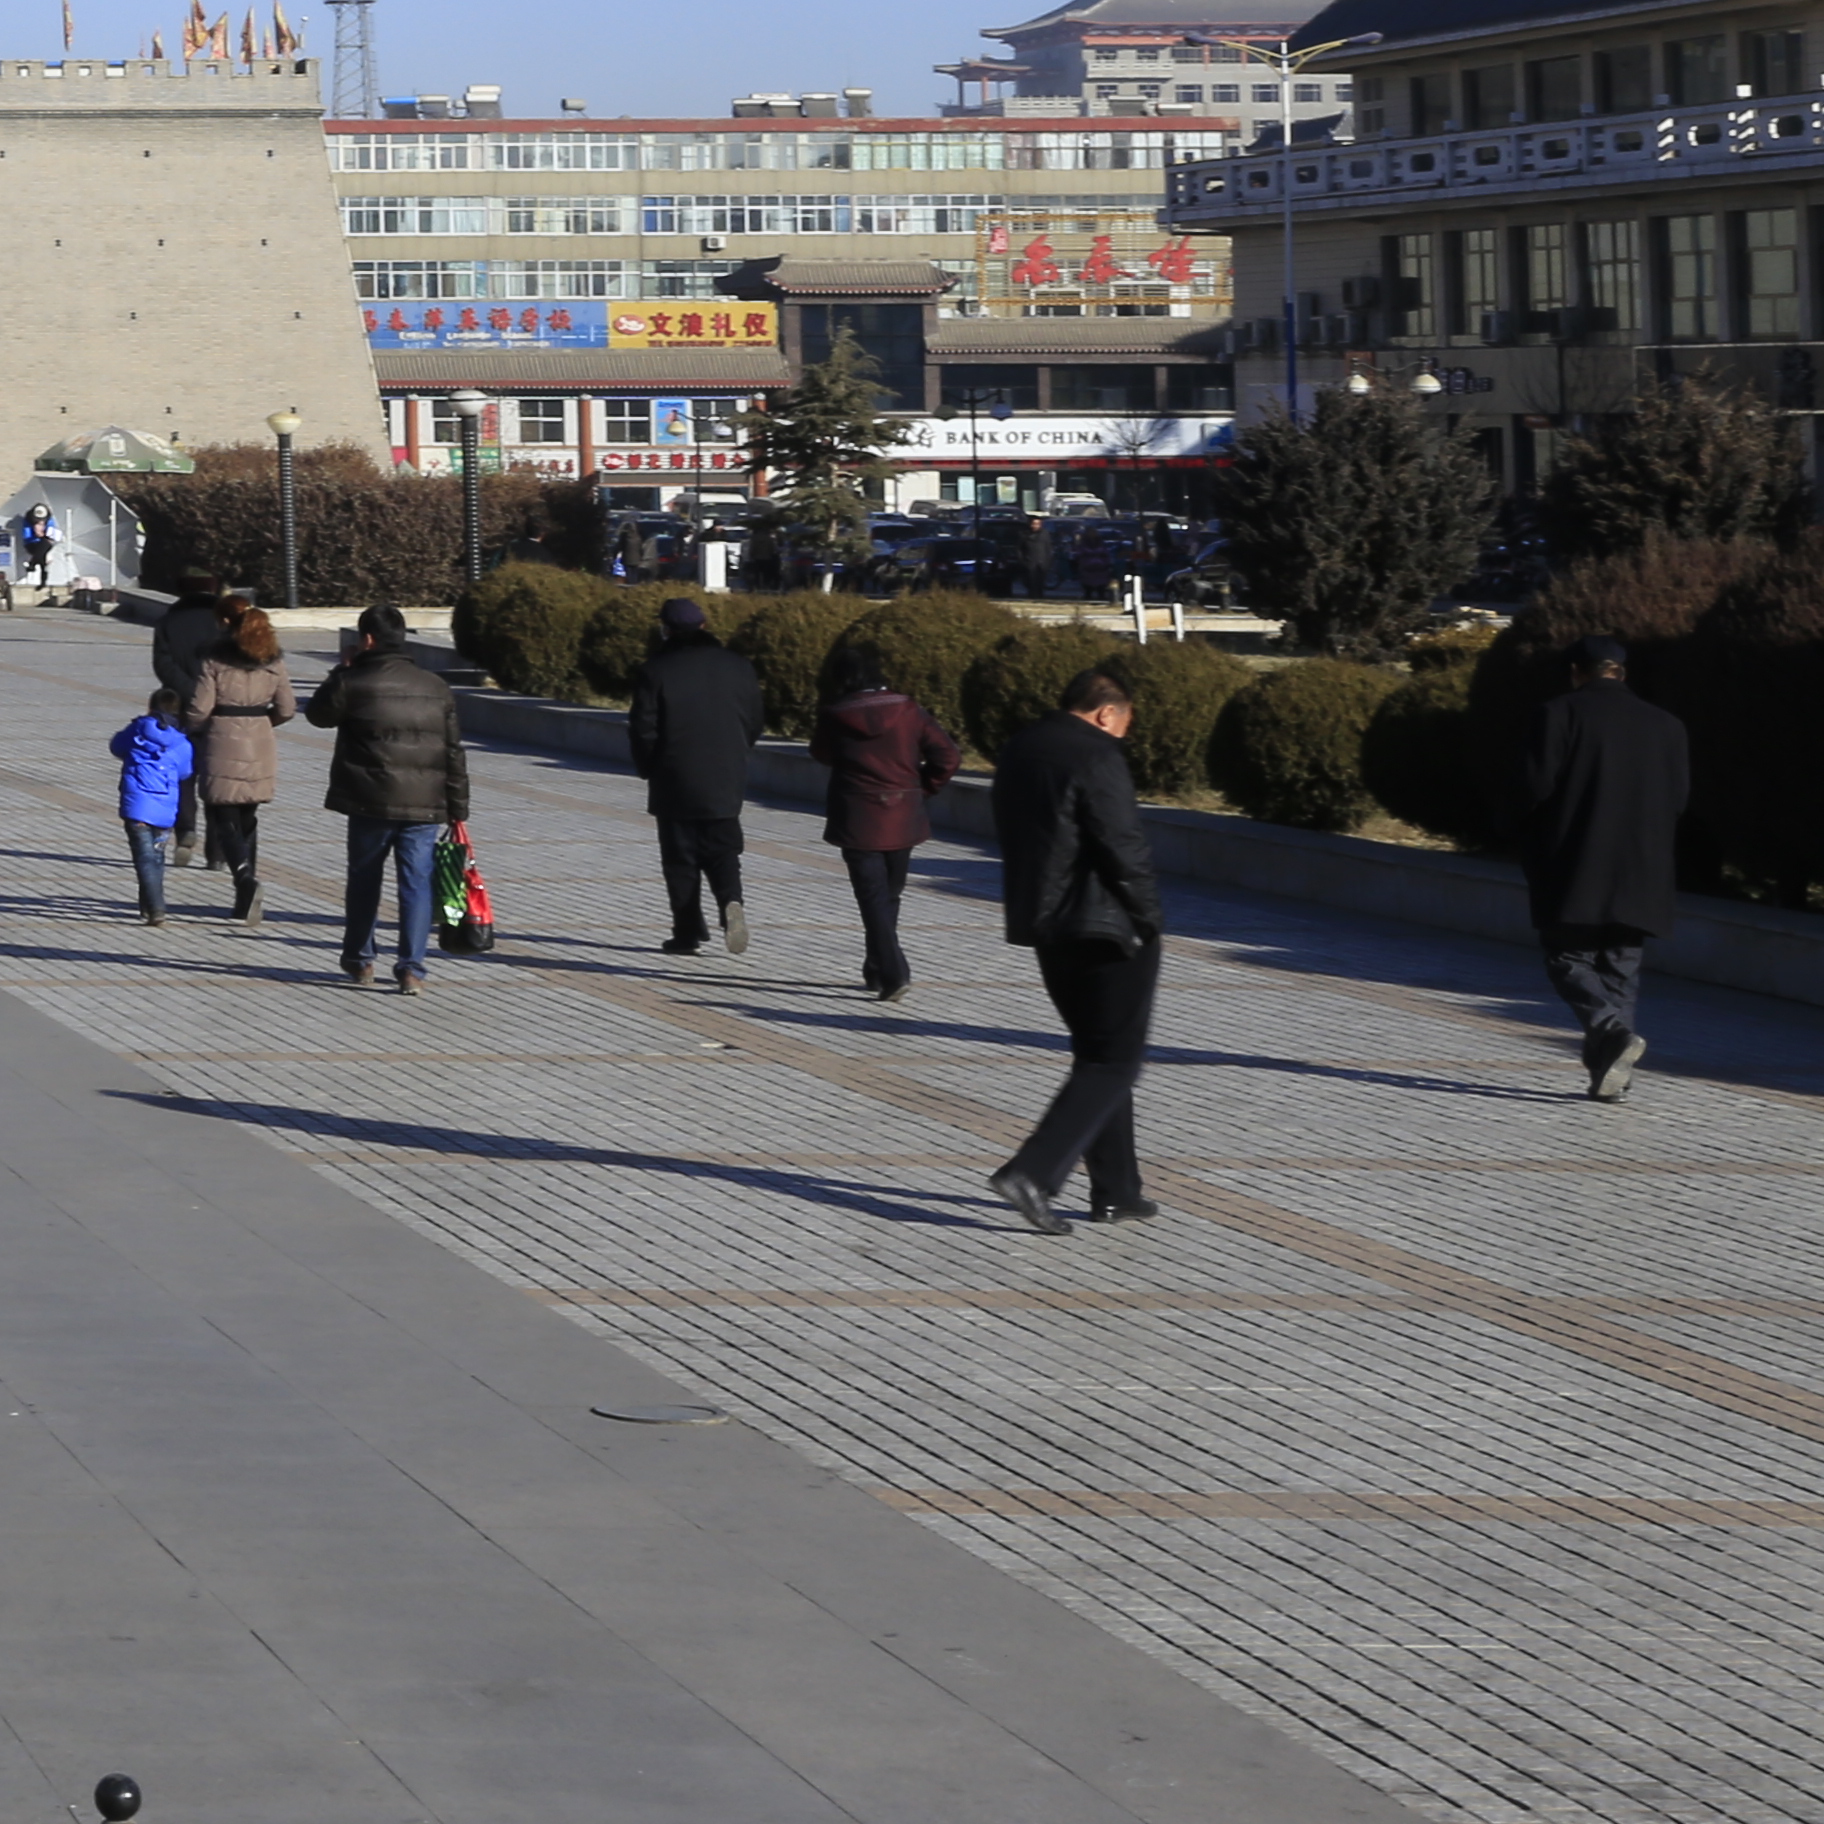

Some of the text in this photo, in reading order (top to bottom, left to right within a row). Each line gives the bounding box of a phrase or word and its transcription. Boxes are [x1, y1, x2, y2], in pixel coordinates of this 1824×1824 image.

[945, 431, 1001, 445] BANK
[1005, 431, 1032, 445] OF
[1037, 431, 1105, 445] CHINA
